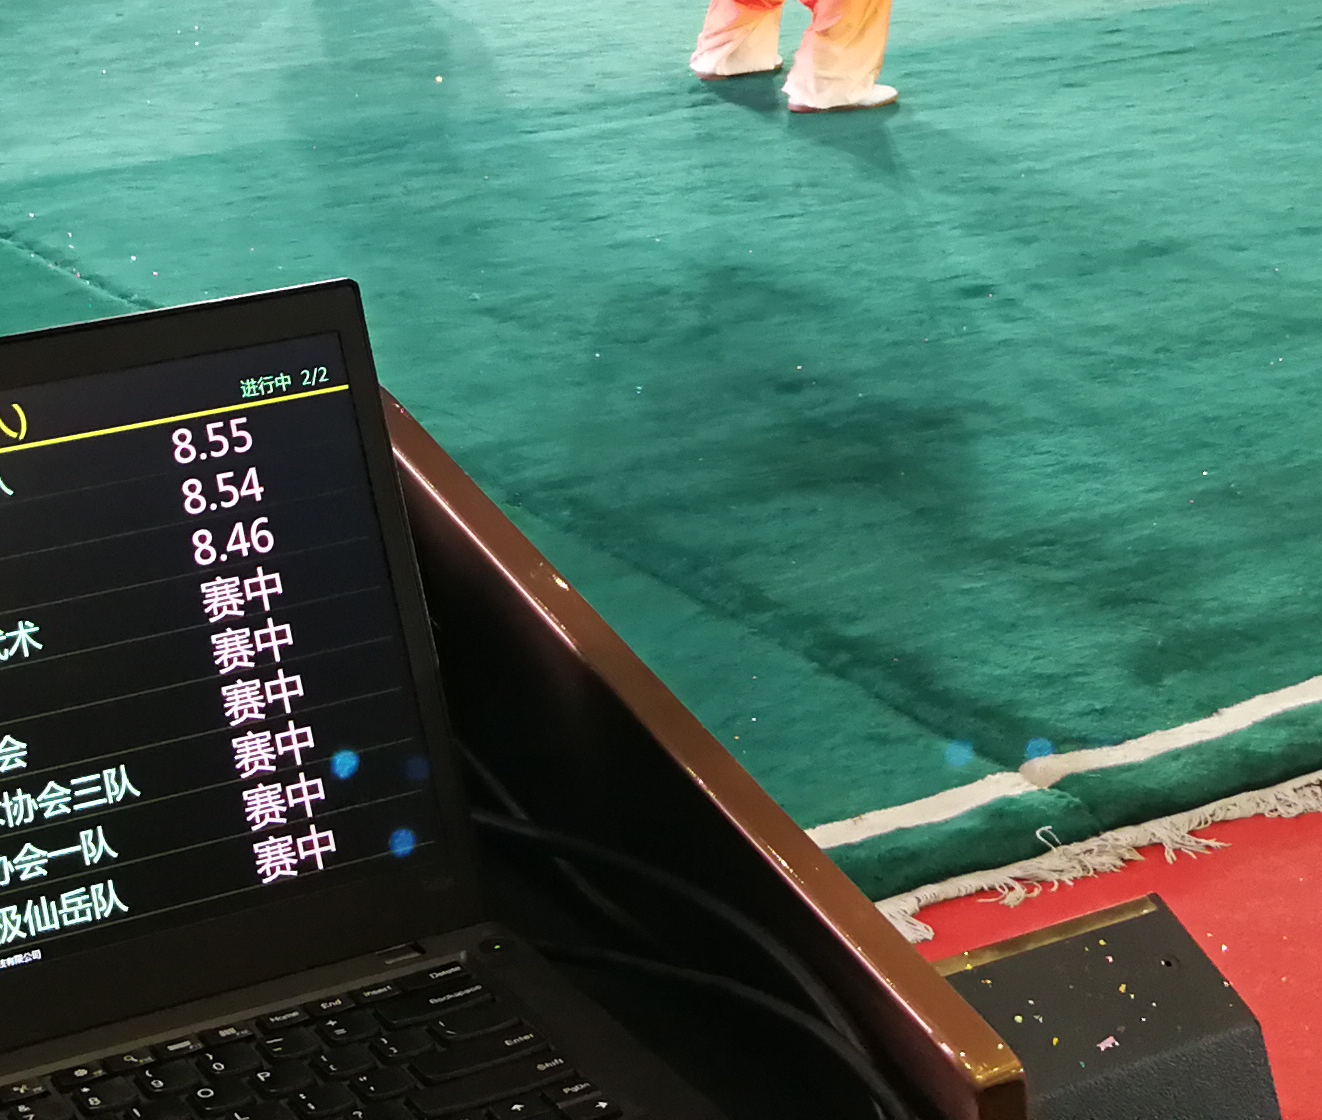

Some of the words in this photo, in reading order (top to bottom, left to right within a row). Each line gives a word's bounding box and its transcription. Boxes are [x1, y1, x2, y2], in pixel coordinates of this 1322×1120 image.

[240, 372, 292, 398] 进行中
[300, 366, 329, 387] 2/2
[171, 416, 253, 464] 8.55
[181, 466, 265, 515] 8.54
[191, 516, 275, 566] 8.46
[200, 566, 283, 624] 赛中
[210, 617, 294, 675] 赛中
[221, 668, 304, 727] 赛中
[231, 719, 315, 779] 赛中
[242, 771, 326, 831] 赛中
[252, 823, 337, 884] 赛中
[269, 1011, 299, 1023] Home
[320, 998, 342, 1009] End
[504, 1033, 534, 1046] Enter
[256, 1071, 271, 1082] P
[536, 1058, 564, 1071] Shift
[562, 1082, 591, 1094] PgDn
[196, 1088, 215, 1098] O
